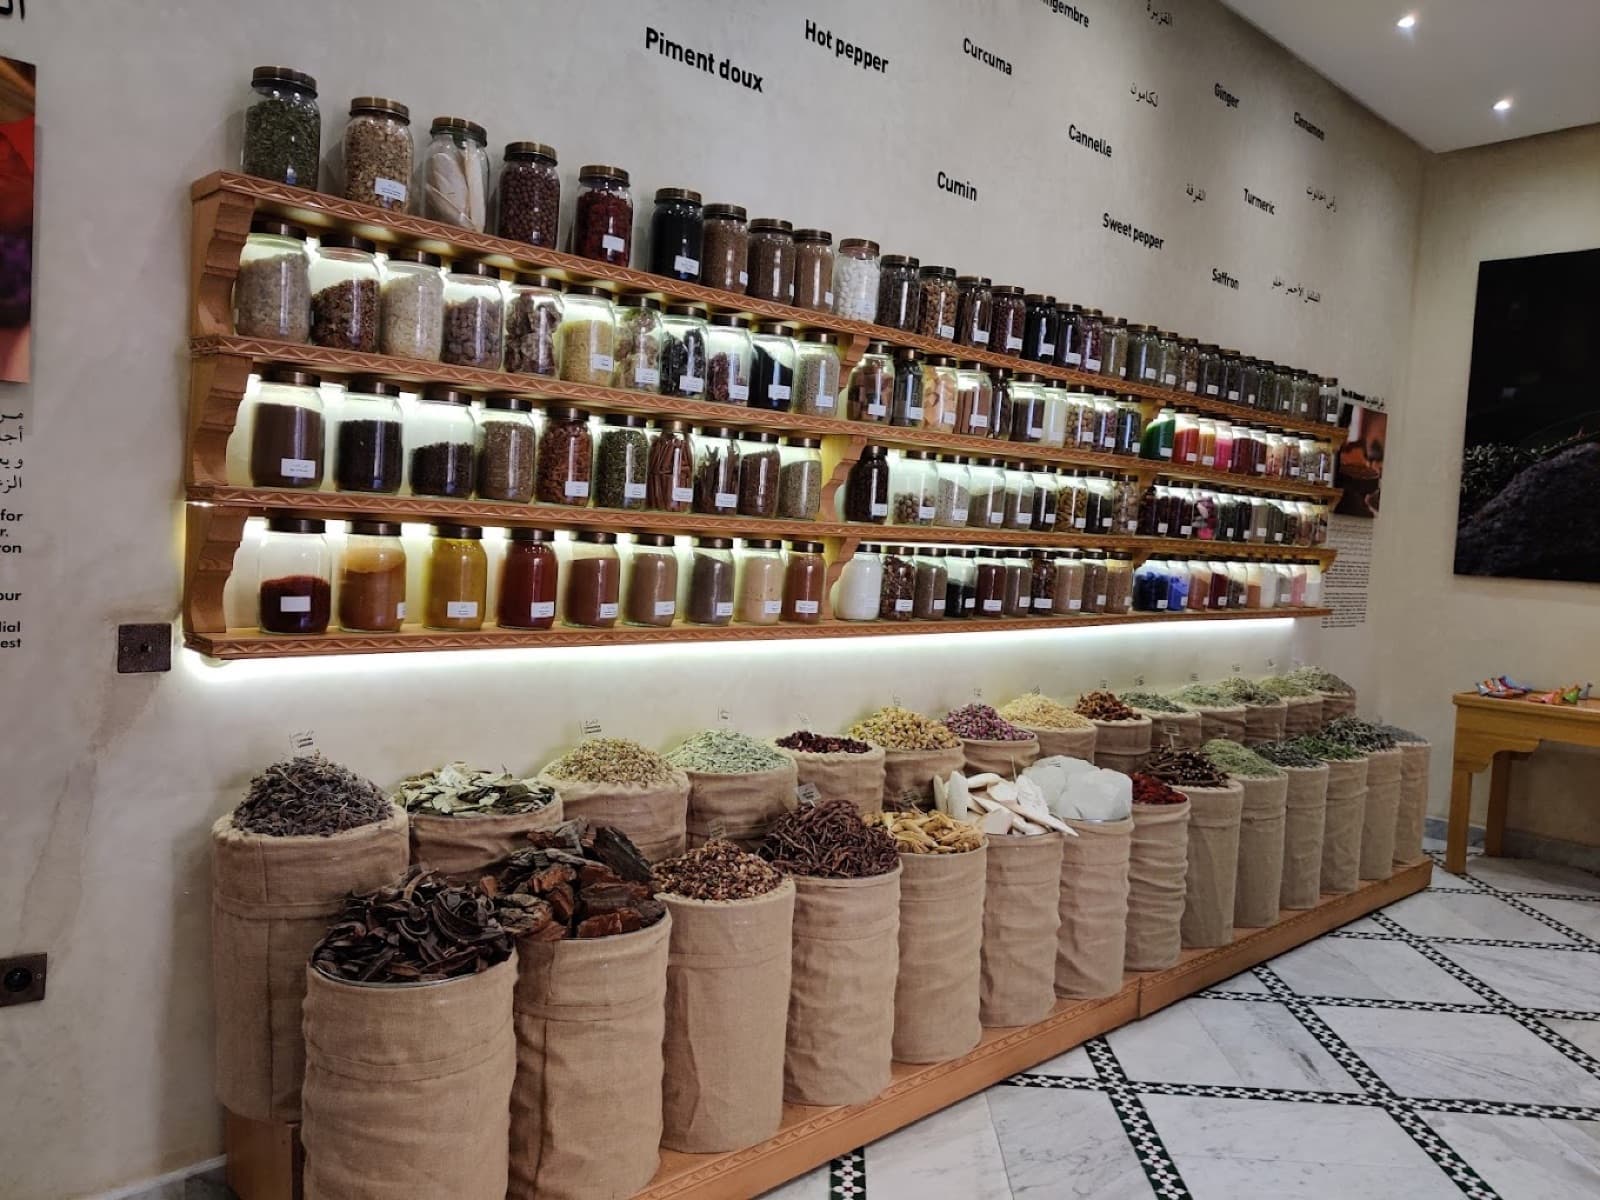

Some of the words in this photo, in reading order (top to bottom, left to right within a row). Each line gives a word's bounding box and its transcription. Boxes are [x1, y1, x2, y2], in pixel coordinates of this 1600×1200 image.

[645, 26, 715, 76] Piment
[719, 56, 763, 93] doux
[805, 18, 833, 50] Hot
[835, 36, 890, 75] pepper
[963, 37, 1013, 76] Curcuma
[1214, 82, 1240, 108] Ginger
[1068, 123, 1112, 158] Cannelle
[1293, 111, 1326, 141] Cinnamon
[937, 170, 978, 202] Cumin
[1243, 187, 1276, 215] Turmeric
[1102, 212, 1133, 237] Sweet
[1133, 226, 1165, 250] pepper
[1211, 267, 1239, 289] Saffron
[0, 507, 24, 522] for
